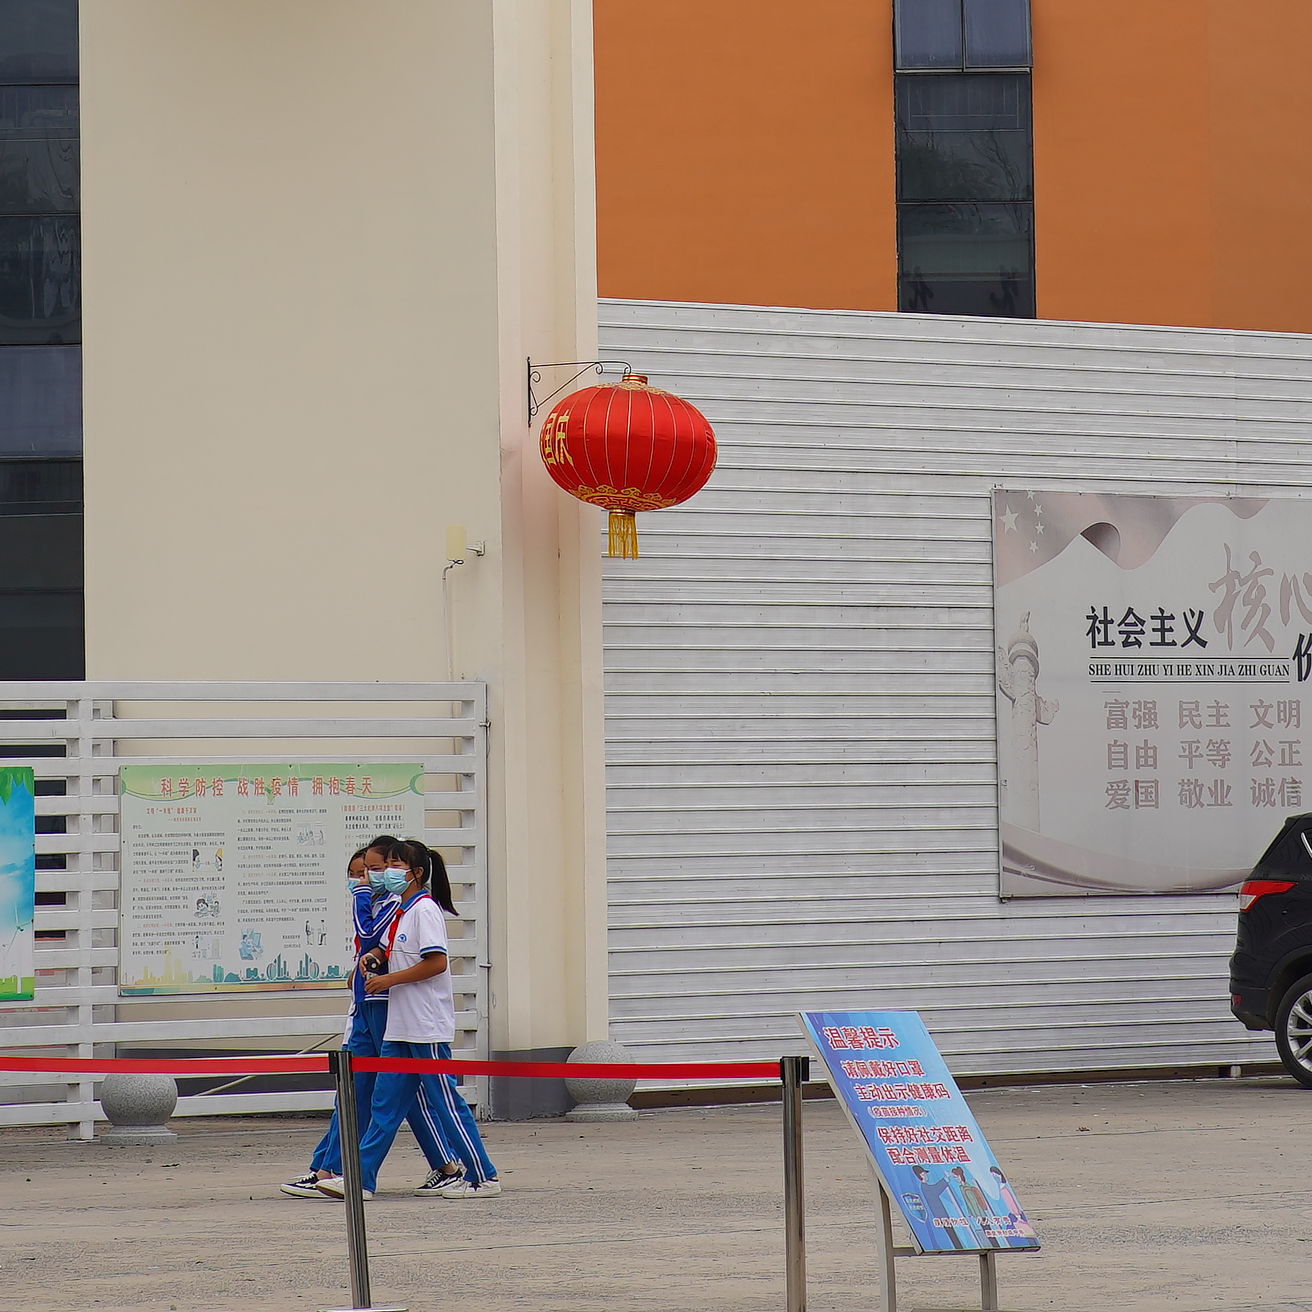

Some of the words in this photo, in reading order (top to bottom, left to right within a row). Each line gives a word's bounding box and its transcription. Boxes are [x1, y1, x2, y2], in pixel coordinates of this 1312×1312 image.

[1086, 606, 1208, 649] 社会主义
[1088, 664, 1111, 677] SHE
[1114, 664, 1135, 677] HUI
[1138, 664, 1160, 677] ZHU
[1162, 664, 1173, 677] YI
[1176, 664, 1192, 677] HE
[1195, 664, 1215, 677] XIN
[1217, 664, 1235, 677] JIA
[1238, 664, 1256, 677] ZHI
[1259, 664, 1290, 677] GUAN
[1103, 698, 1160, 730] 富强
[1178, 699, 1231, 730] 民主
[1249, 699, 1301, 729] 文明
[1107, 739, 1158, 770] 自由
[1178, 739, 1232, 769] 平等
[1249, 739, 1303, 768] 公正
[161, 777, 224, 797] 科学防控
[237, 776, 299, 797] 战胜疫情
[312, 776, 373, 796] 拥抱春天
[1105, 779, 1160, 810] 爱国
[1178, 779, 1233, 809] 敬业
[1250, 776, 1303, 808] 诚信
[822, 1026, 901, 1051] 温馨提示
[840, 1059, 927, 1080] 请佩戴好口罩
[853, 1083, 951, 1102] 主动出示健康码
[877, 1125, 974, 1145] 保持好社交距离
[886, 1146, 972, 1166] 配合测量体温
